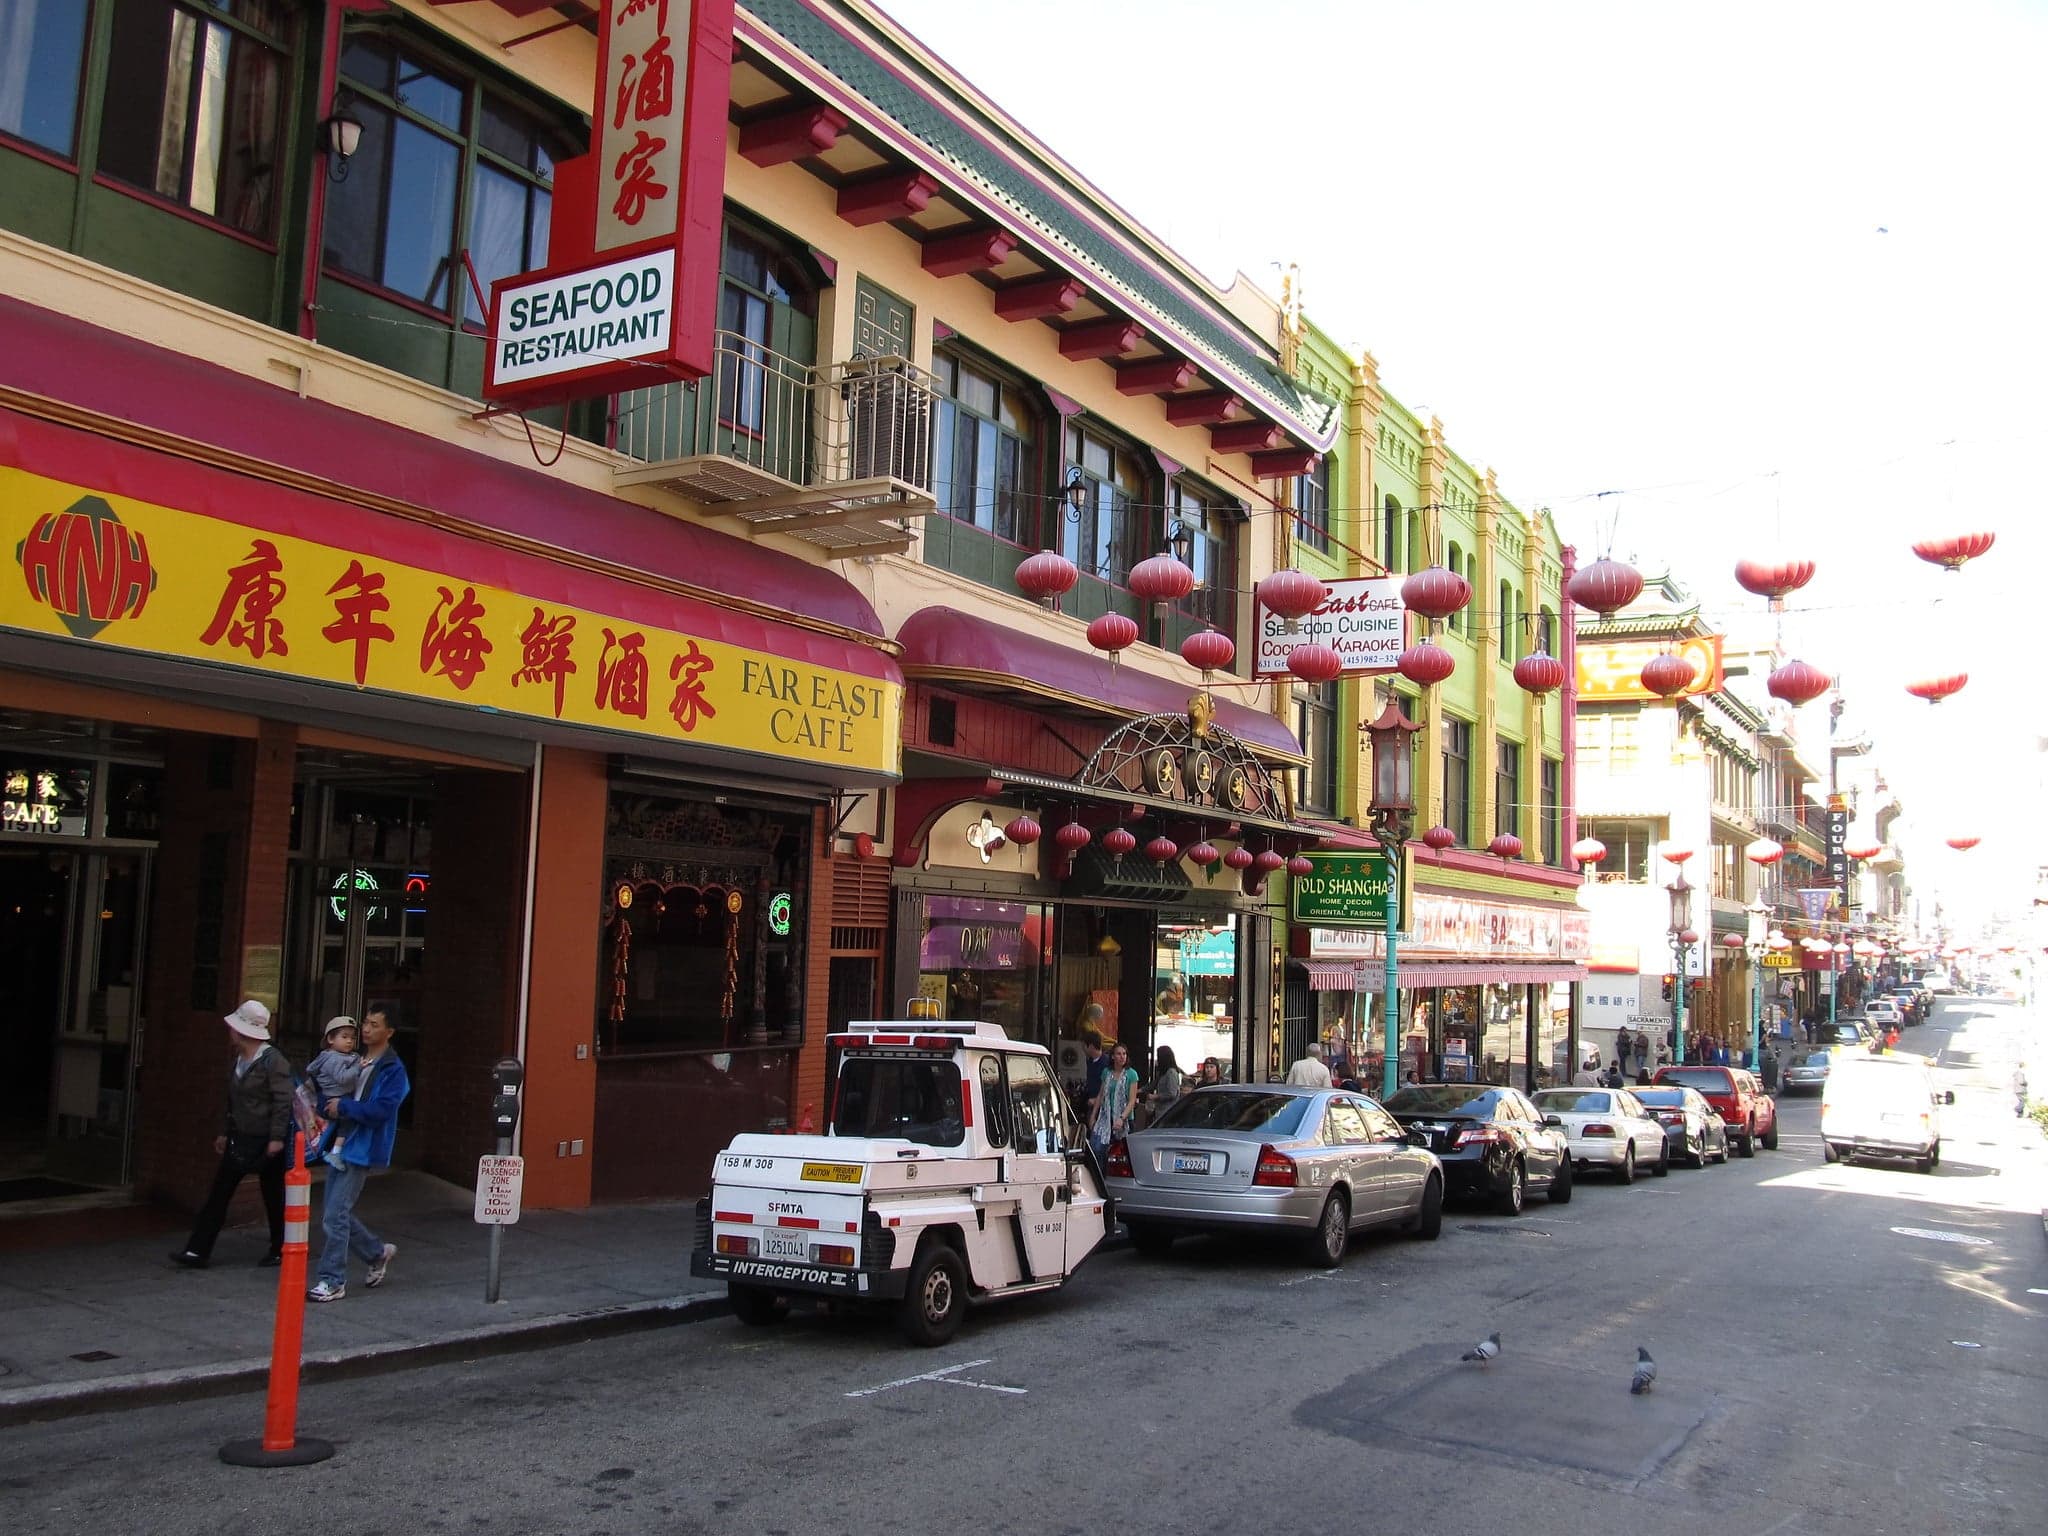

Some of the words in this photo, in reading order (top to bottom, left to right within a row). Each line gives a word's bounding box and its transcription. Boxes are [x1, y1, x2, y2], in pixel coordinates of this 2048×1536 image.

[508, 267, 662, 332] SEAFOOD
[502, 309, 665, 369] RESTAURANT
[22, 512, 151, 620] HNH
[1264, 620, 1333, 637] SEFOOD
[1338, 616, 1399, 634] CUISINE
[200, 538, 716, 732] 康年海鮮酒家
[1331, 636, 1400, 653] KARAOKE
[1343, 654, 1401, 665] (415)982-324
[742, 658, 802, 706] FAR
[811, 675, 884, 720] EAST
[769, 707, 854, 753] CAFÉ
[1831, 812, 1845, 855] FOUR
[1300, 877, 1325, 895] OLD
[1328, 878, 1389, 896] SHANGHA
[1345, 898, 1373, 906] DECOR
[1310, 908, 1346, 916] ORIENTAL
[1350, 909, 1383, 917] FASHION
[1764, 956, 1789, 965] KITES
[1585, 995, 1636, 1007] 美國銀行
[1629, 1015, 1671, 1025] SACRAMENTO
[481, 1159, 491, 1167] NO
[493, 1159, 522, 1168] PARKING
[723, 1157, 739, 1168] 158
[742, 1158, 752, 1169] M
[754, 1159, 774, 1170] 308
[481, 1167, 521, 1177] PASSENGER
[806, 1167, 831, 1177] CAUTION
[832, 1166, 858, 1175] FREQUENT
[491, 1176, 511, 1185] ZONE
[484, 1207, 512, 1216] DAILY
[768, 1202, 804, 1215] SFMTA
[1034, 1223, 1044, 1234] 158
[1045, 1223, 1051, 1233] M
[766, 1239, 805, 1257] 1251041
[732, 1261, 830, 1284] INTERCEPTOR
